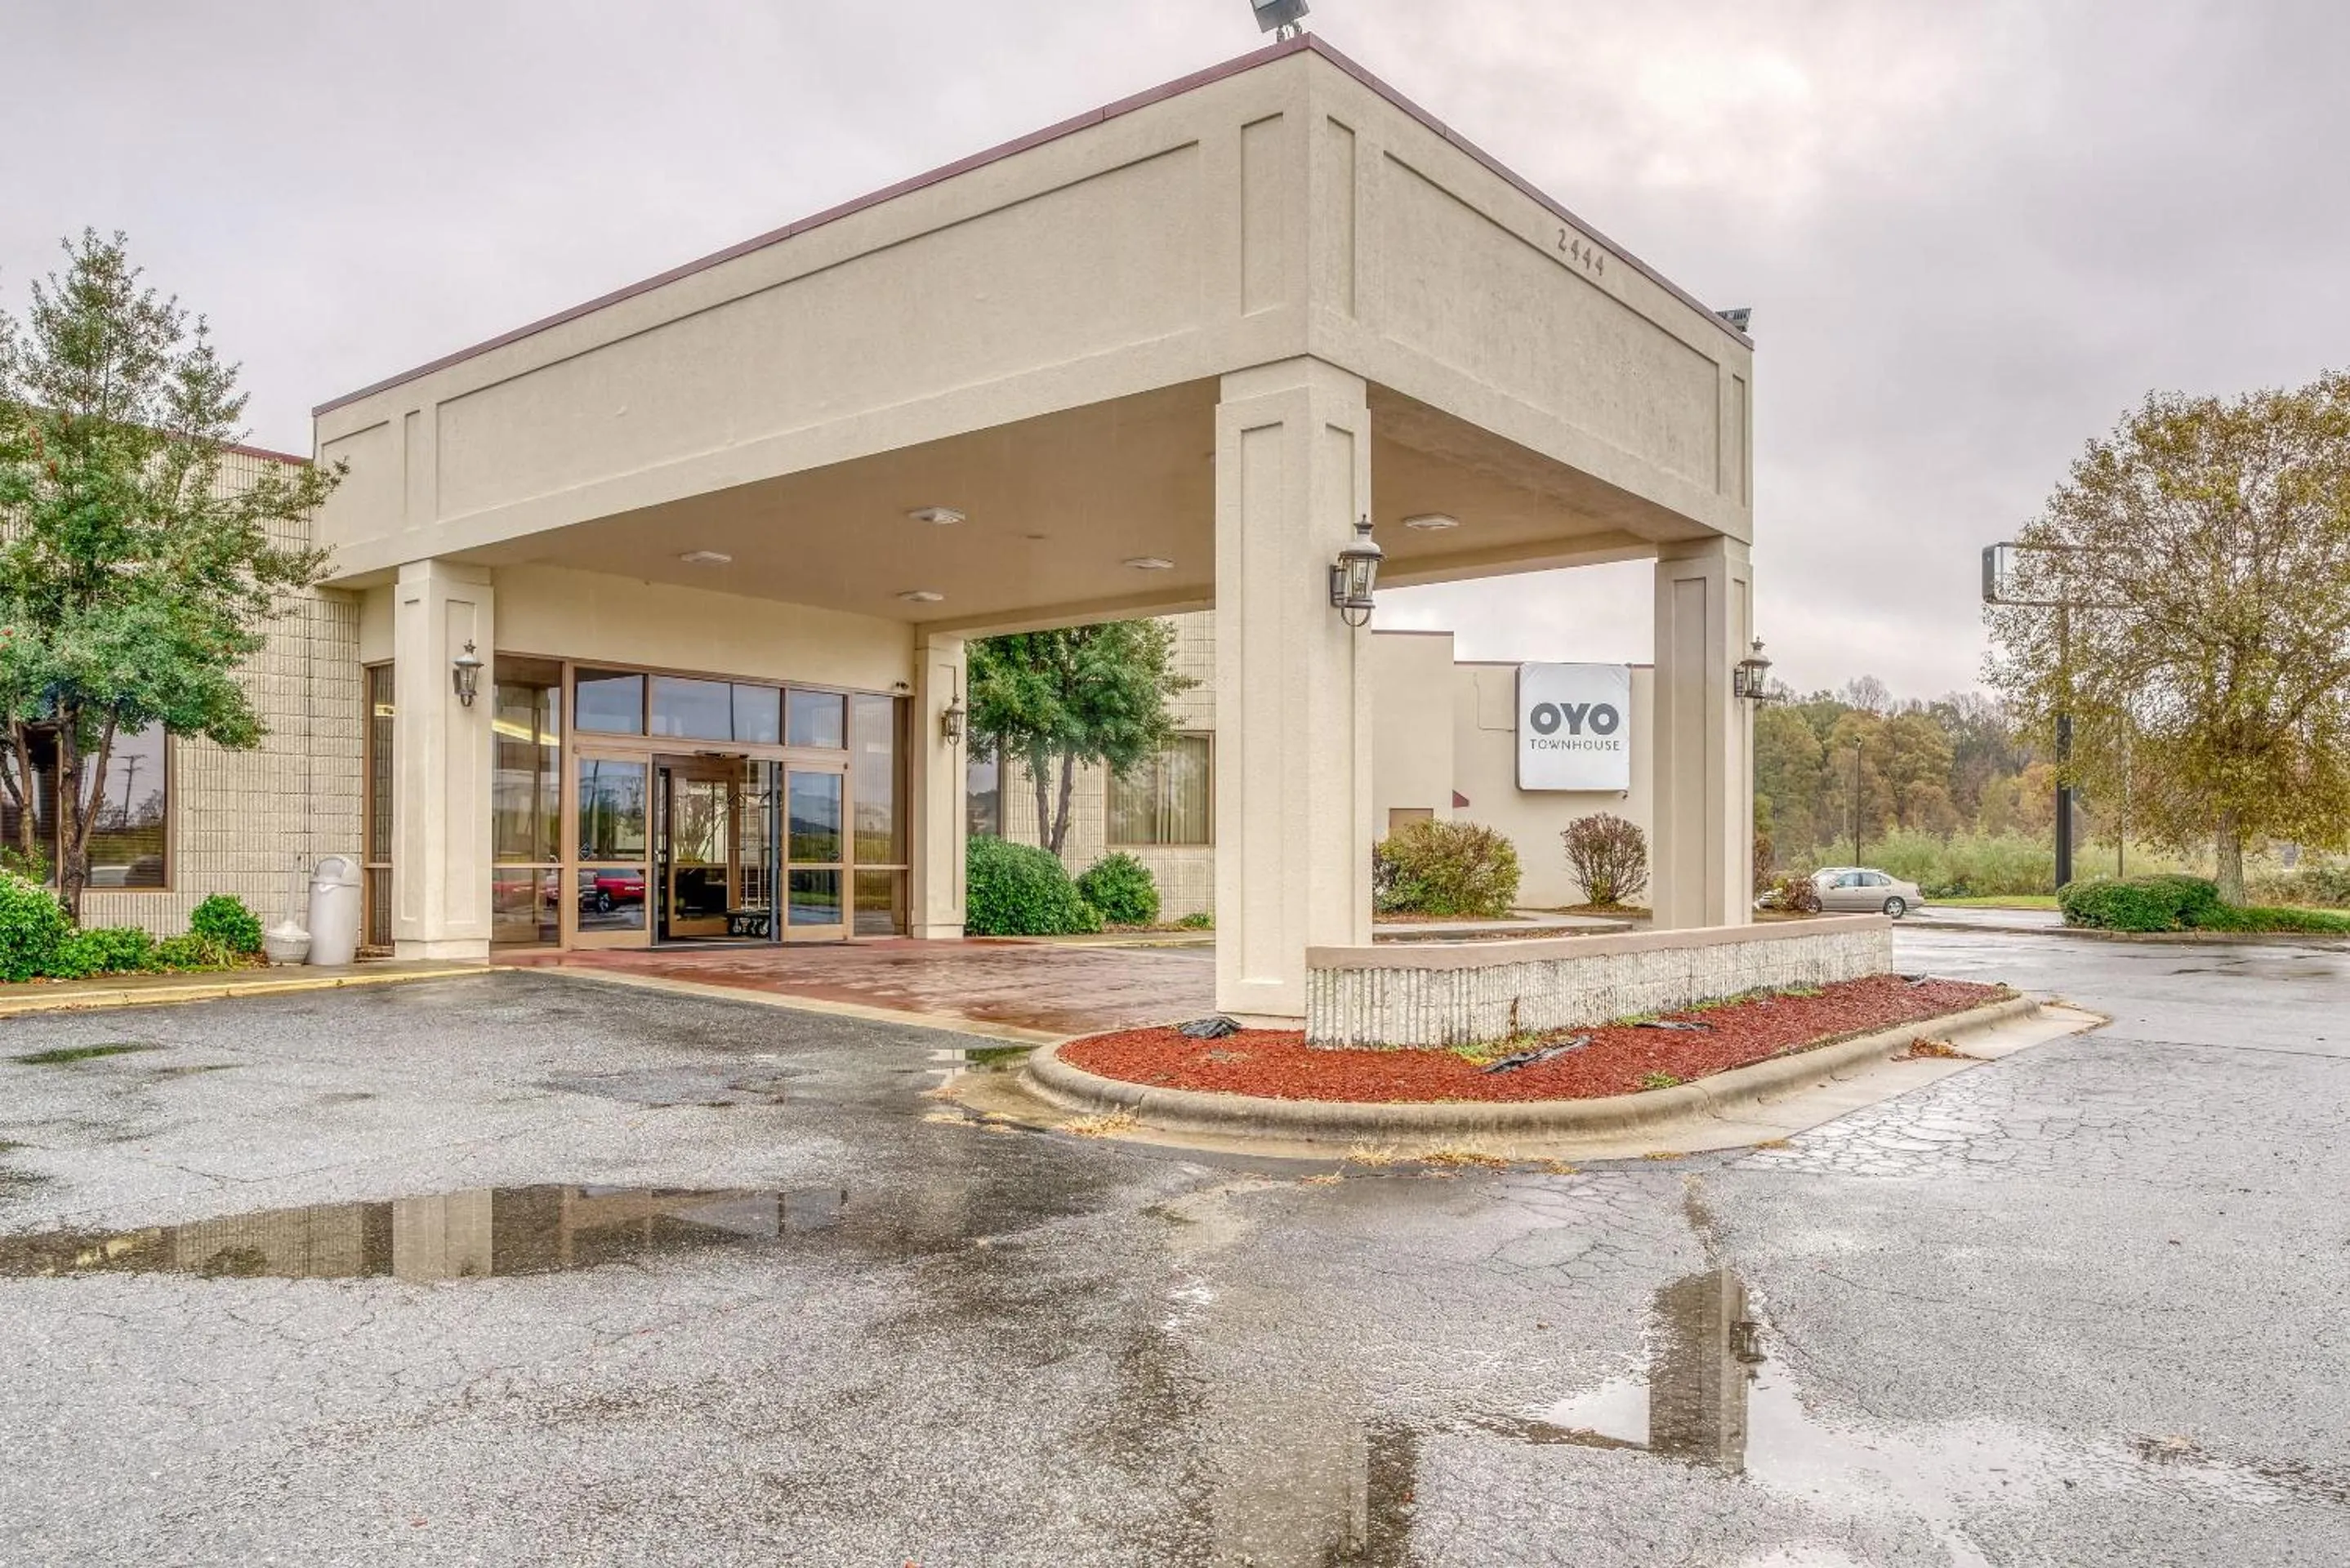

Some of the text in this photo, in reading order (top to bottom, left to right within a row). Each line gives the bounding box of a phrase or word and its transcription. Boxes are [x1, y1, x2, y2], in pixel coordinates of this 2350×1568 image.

[1558, 229, 1603, 276] 2444
[1530, 702, 1620, 735] OYO
[1530, 738, 1621, 751] TOWNHOUSE
